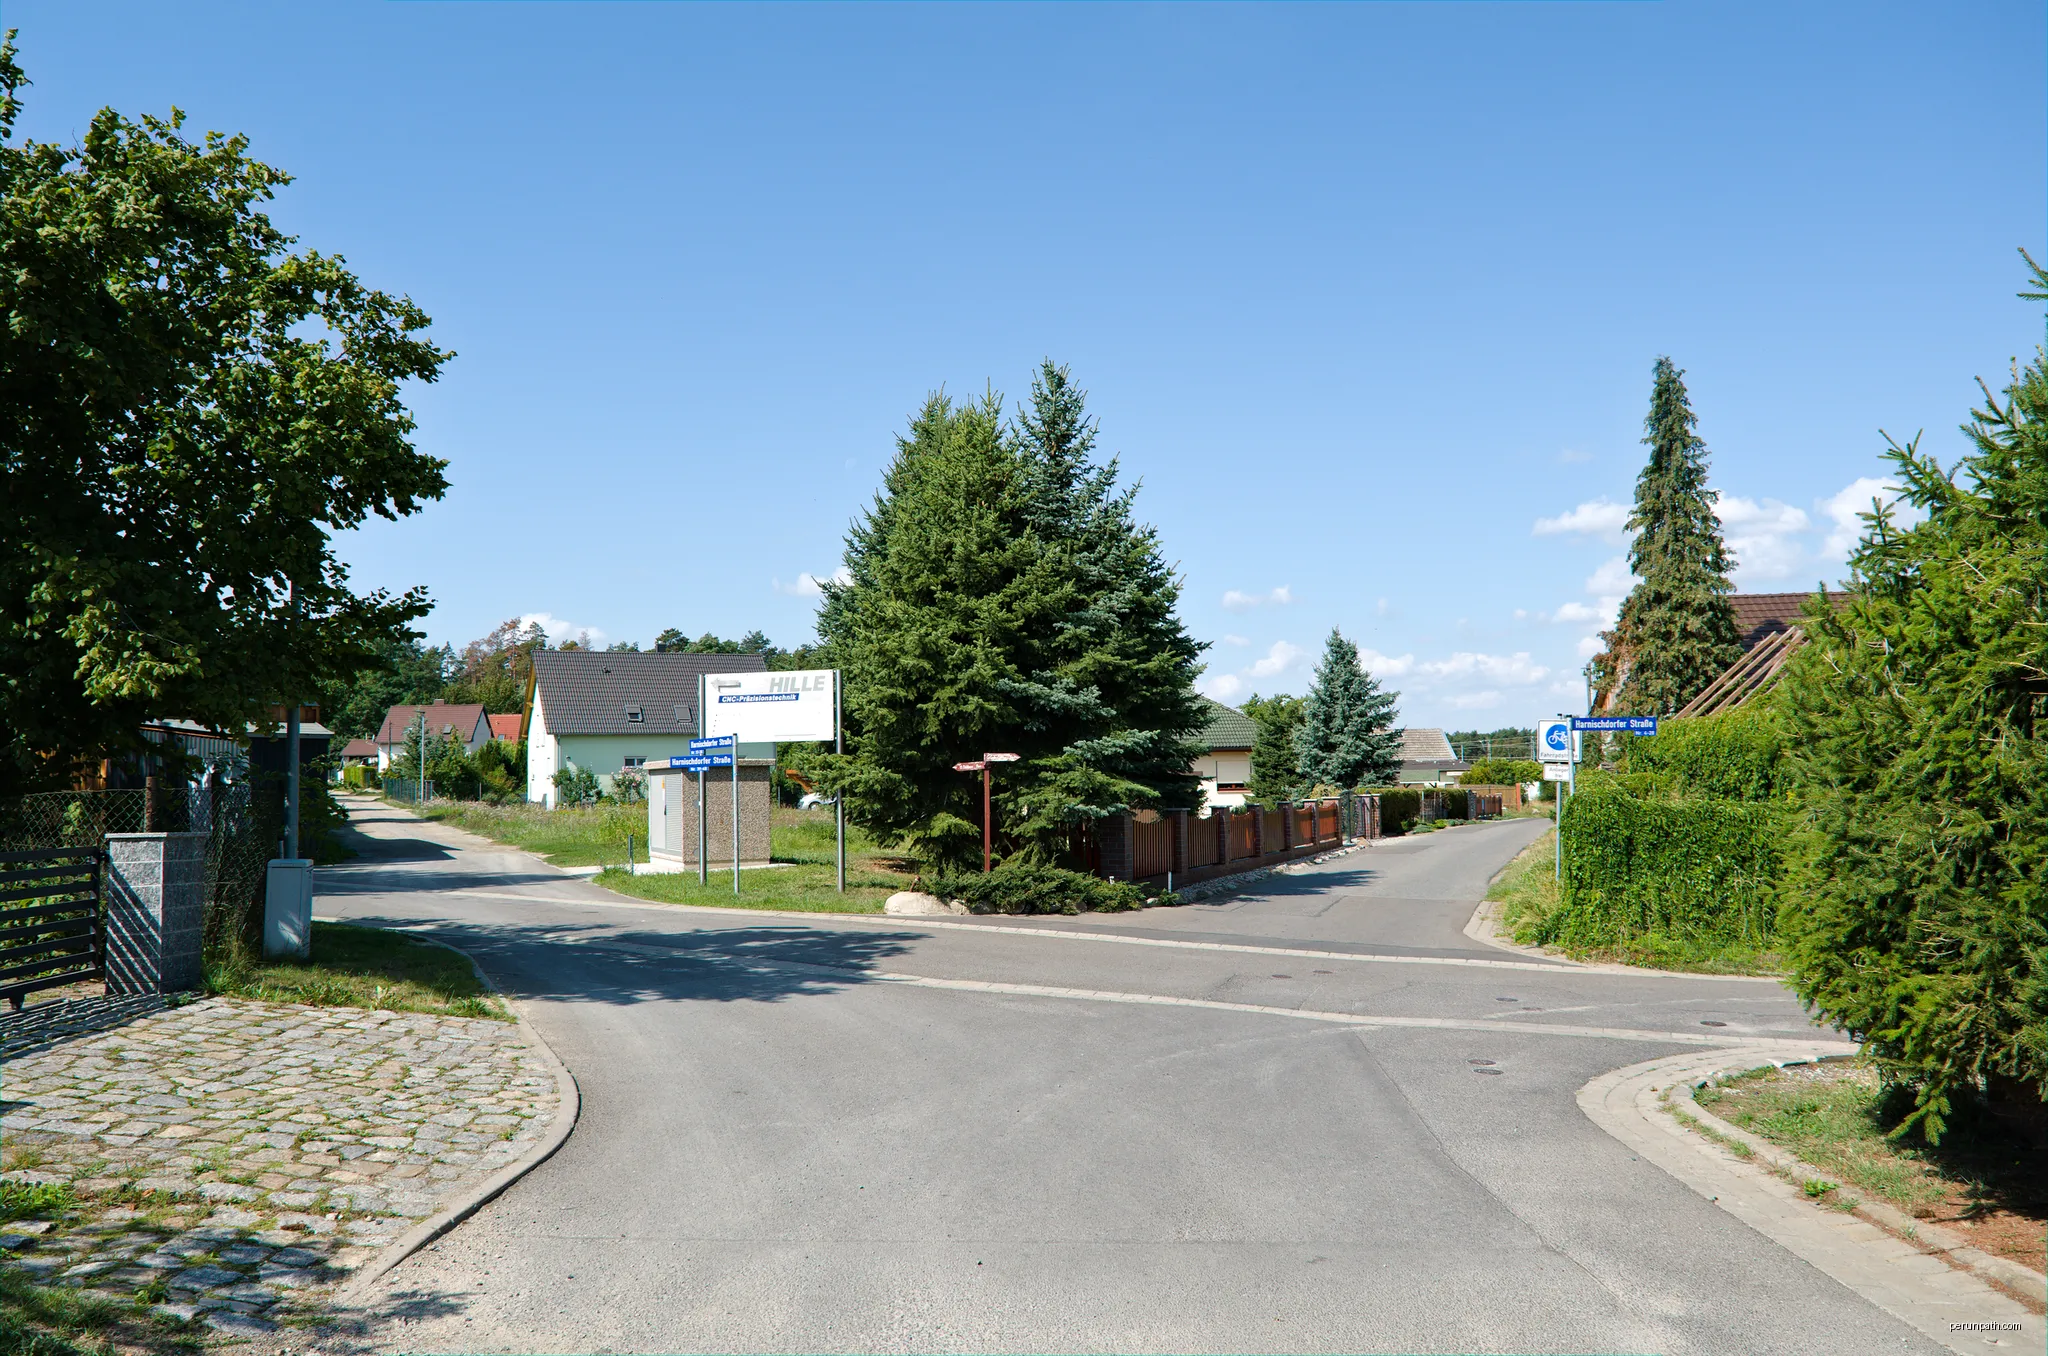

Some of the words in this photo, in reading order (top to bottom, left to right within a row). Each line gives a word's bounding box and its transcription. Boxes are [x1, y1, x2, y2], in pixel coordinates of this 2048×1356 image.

[769, 675, 826, 693] HILLE
[721, 694, 797, 703] CNC-Präzisionstechnik
[1575, 720, 1627, 729] Harnischdorfer
[1630, 719, 1654, 728] Straße
[671, 758, 711, 766] Harnischdorfer
[713, 756, 731, 764] Straße
